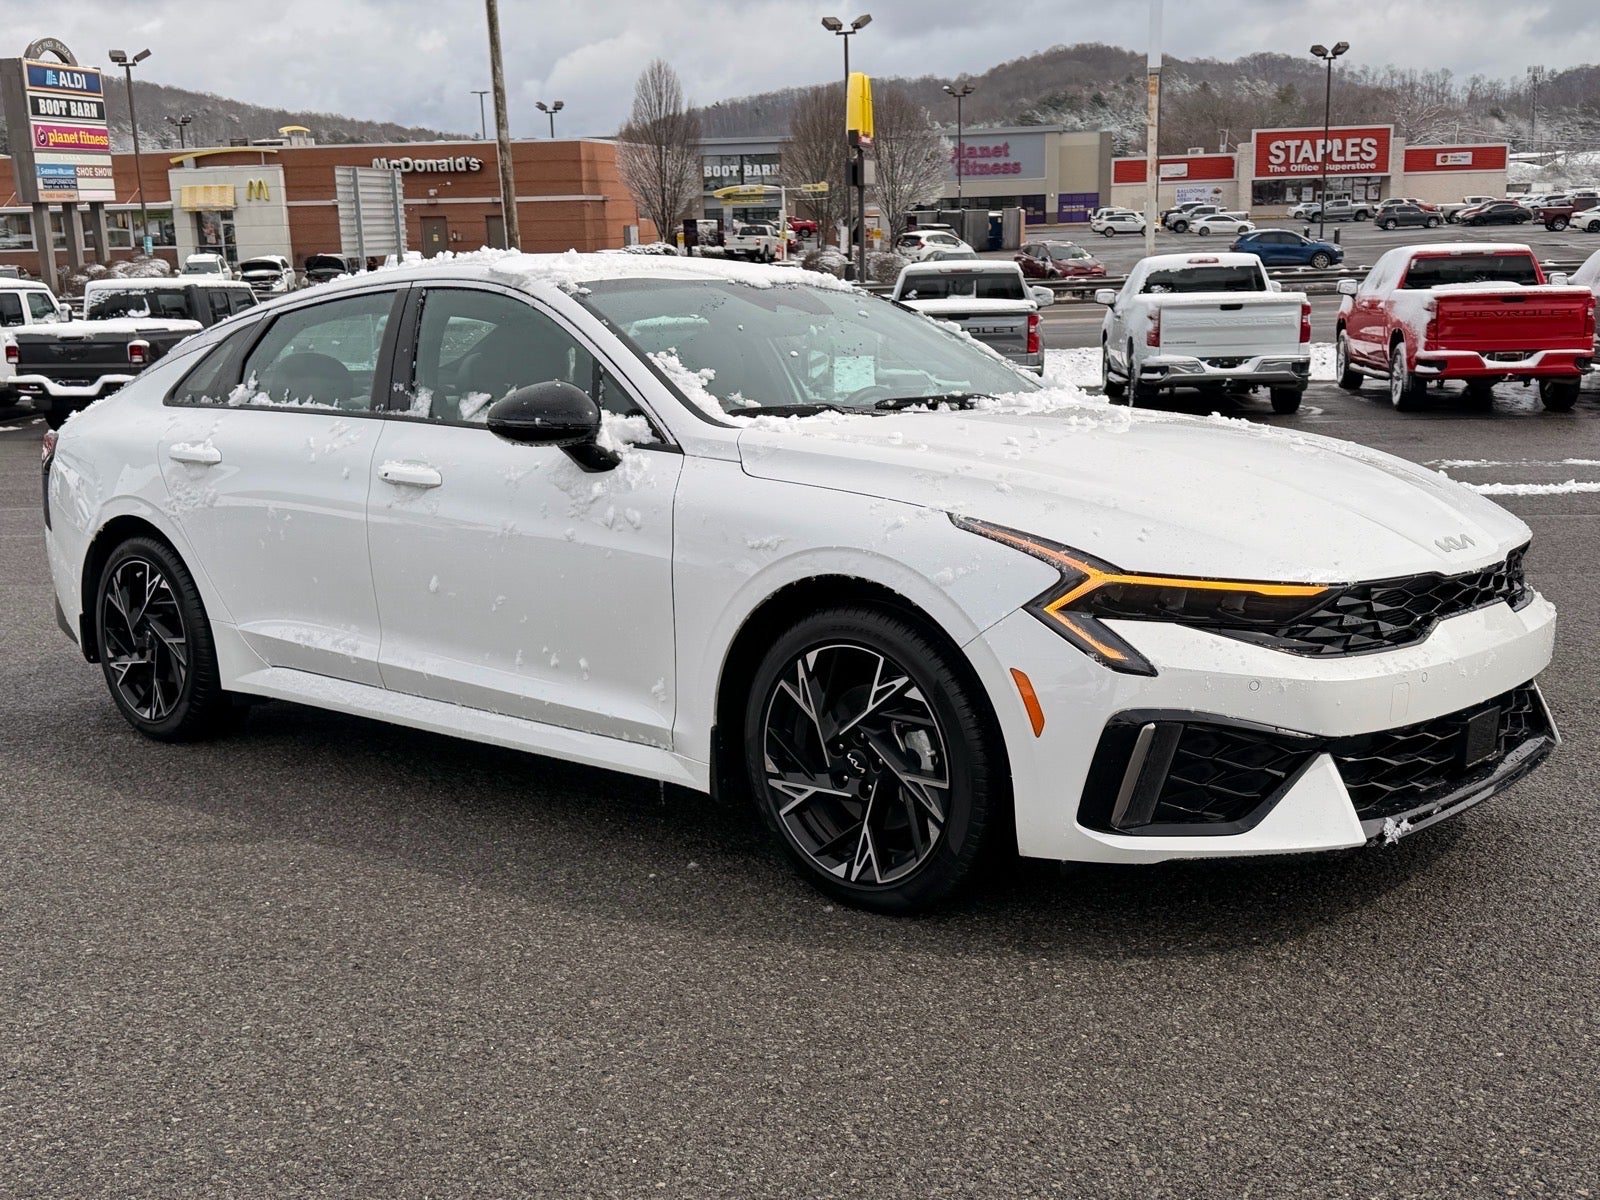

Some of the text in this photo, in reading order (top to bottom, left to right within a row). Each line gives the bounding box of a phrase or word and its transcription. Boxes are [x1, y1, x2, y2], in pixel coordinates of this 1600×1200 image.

[59, 71, 87, 90] ALDI
[38, 98, 98, 118] BOOT BARN
[48, 129, 109, 146] planet fitness
[1269, 137, 1378, 164] STAPLES
[76, 167, 113, 177] SHOE SHOW
[372, 157, 483, 173] McDonald's
[703, 162, 780, 178] BOOT BARN
[955, 159, 1022, 176] fitness
[1268, 165, 1287, 173] The
[1290, 163, 1319, 172] Office
[1450, 308, 1578, 319] CHEVROLET
